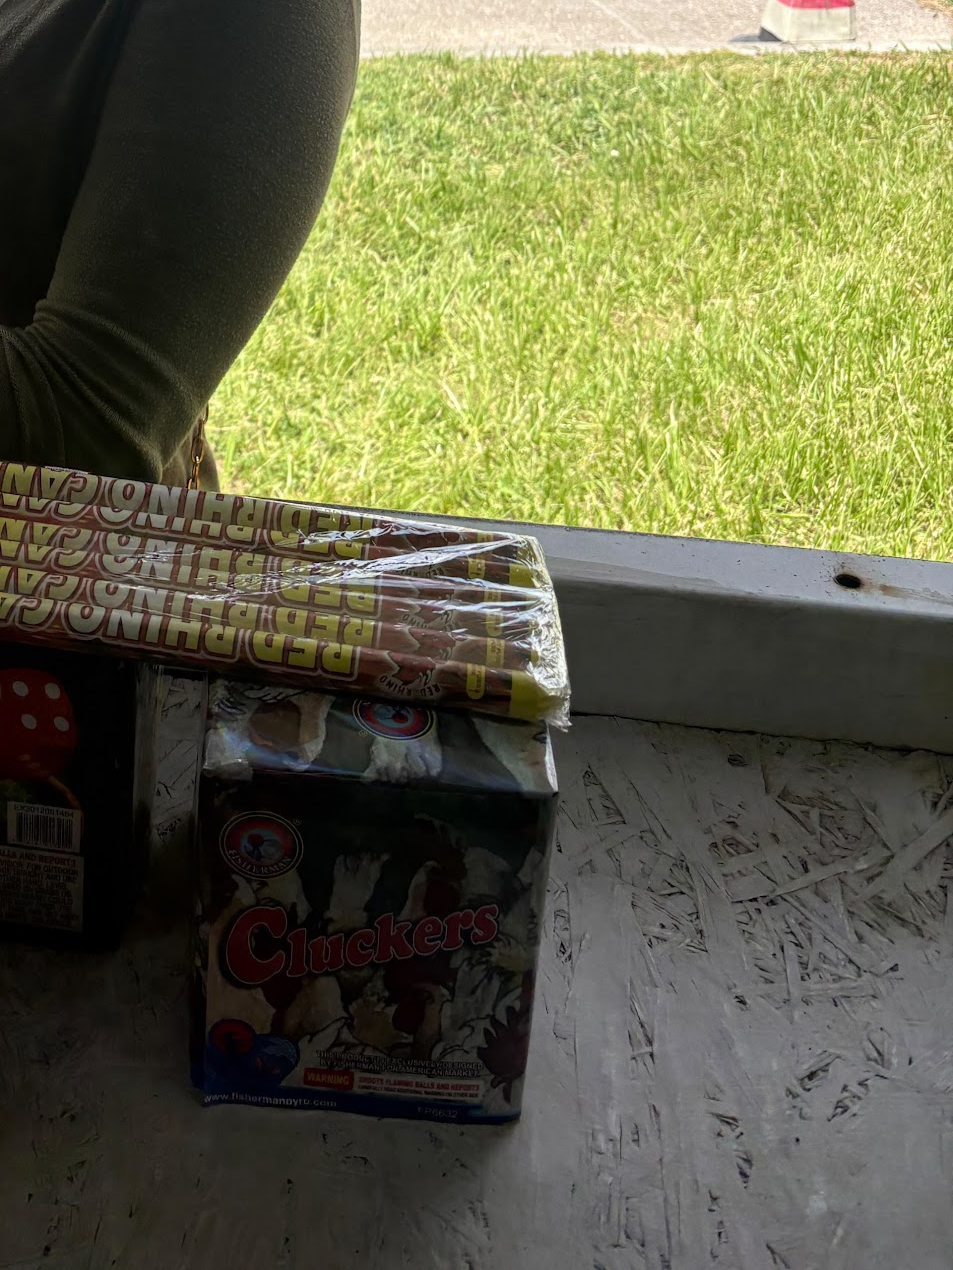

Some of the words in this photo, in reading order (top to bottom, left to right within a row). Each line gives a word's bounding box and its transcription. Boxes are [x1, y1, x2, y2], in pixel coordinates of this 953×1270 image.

[110, 478, 267, 530] RHINO
[92, 579, 258, 631] RHINO
[68, 601, 237, 655] RHINO
[274, 606, 374, 647] RED
[251, 628, 353, 676] RED
[379, 674, 414, 698] RHINO
[419, 684, 442, 697] RED
[227, 847, 295, 876] FISHERMAN
[225, 903, 500, 985] Cluckers
[307, 1072, 350, 1085] WARNING
[387, 1057, 440, 1068] EXCLUSIVELY
[441, 1061, 484, 1071] DESIGNED
[398, 1065, 443, 1076] AMERICAN
